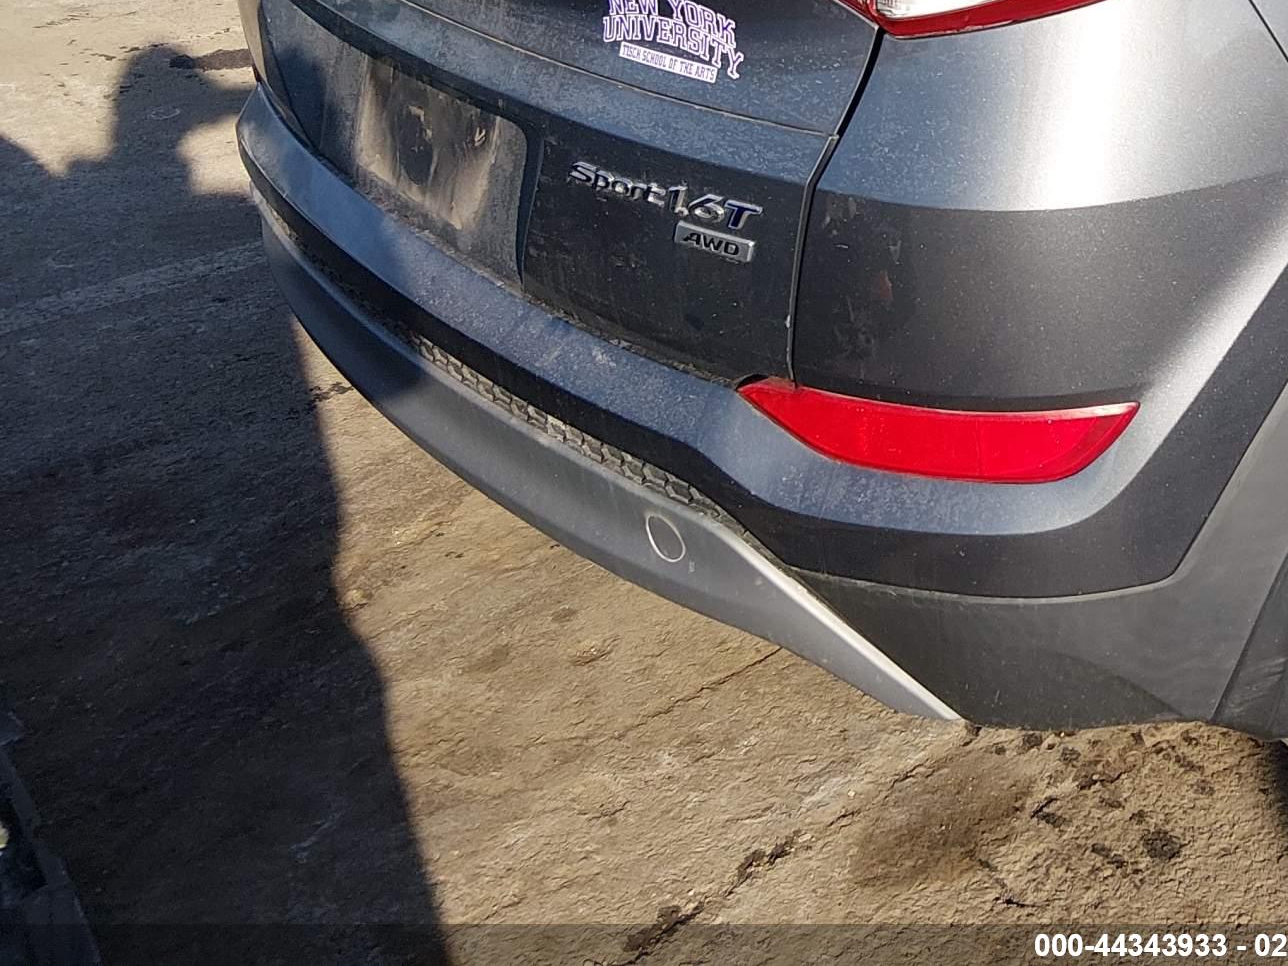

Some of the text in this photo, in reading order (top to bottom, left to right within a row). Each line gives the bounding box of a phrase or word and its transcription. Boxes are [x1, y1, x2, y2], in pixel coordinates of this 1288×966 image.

[603, 15, 744, 79] UNIVERSITY
[622, 44, 716, 80] TISCH SCHOOL OF THE ARTS
[569, 161, 763, 230] Sport 1.6T
[683, 232, 739, 256] AWD
